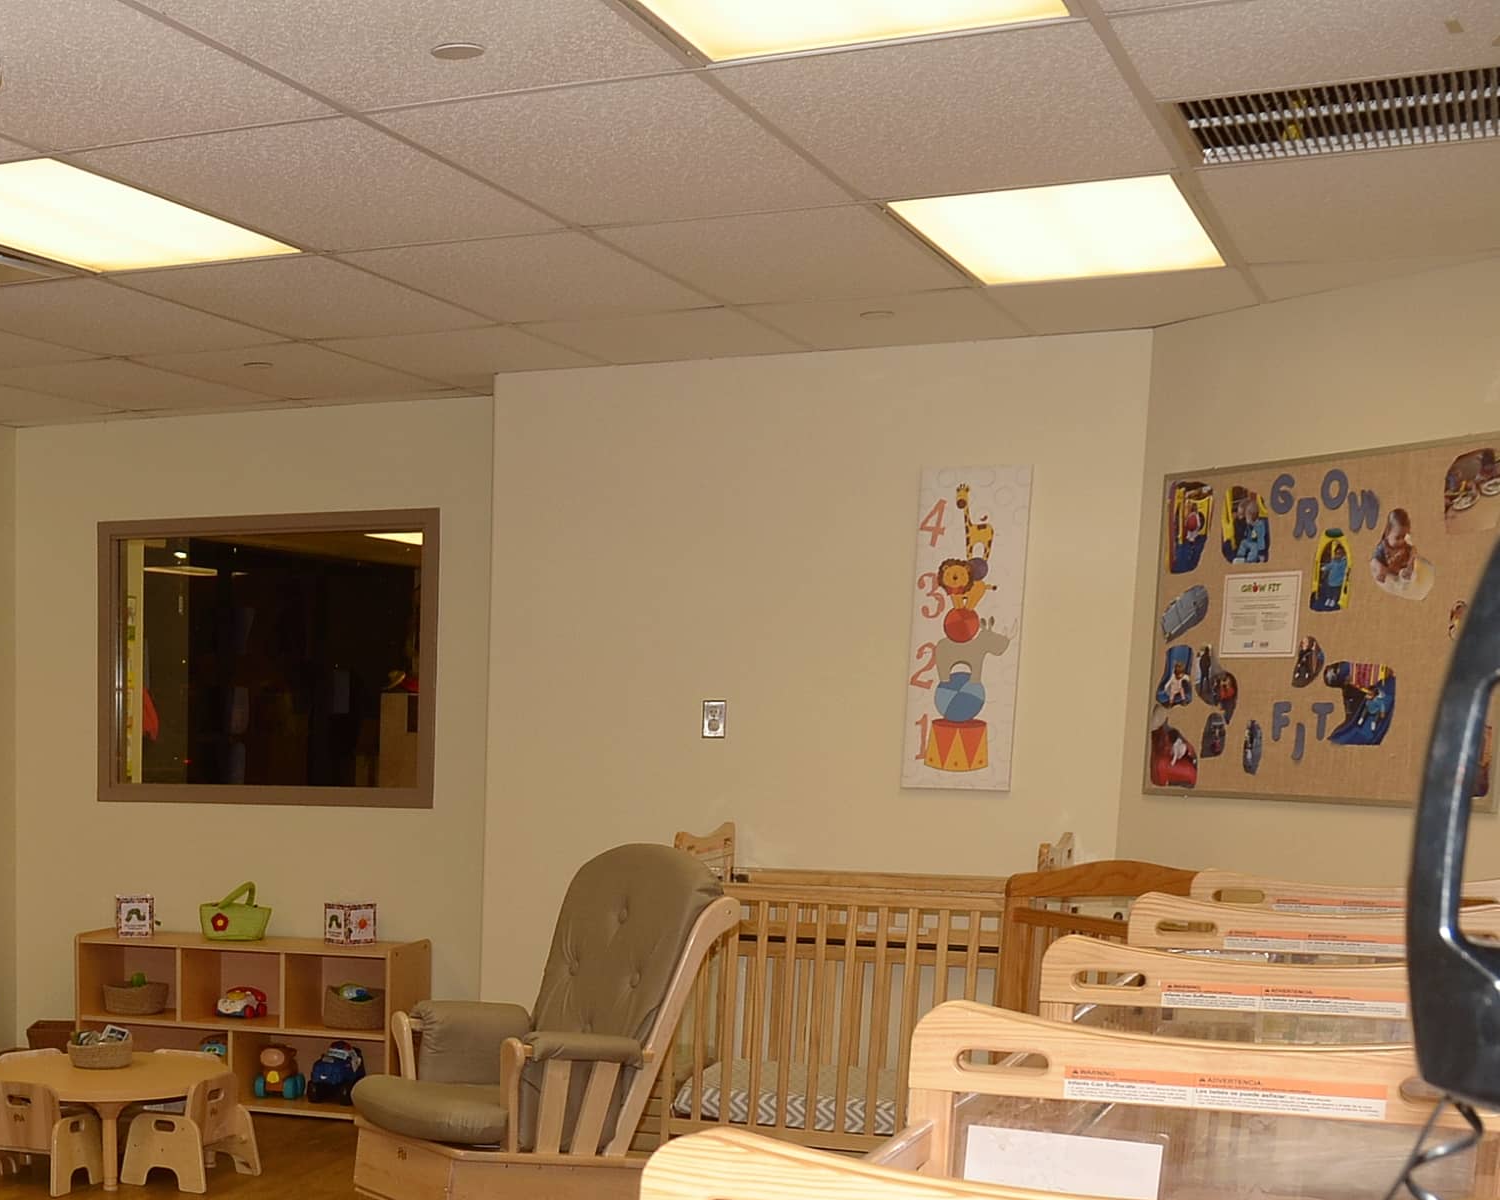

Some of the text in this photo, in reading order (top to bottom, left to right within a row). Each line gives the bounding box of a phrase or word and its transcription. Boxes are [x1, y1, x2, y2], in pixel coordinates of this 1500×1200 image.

[919, 498, 947, 547] 4
[1270, 469, 1380, 540] GROW
[917, 572, 946, 619] 3
[910, 642, 937, 690] 2
[914, 713, 928, 760] 1
[1271, 700, 1334, 763] FIT
